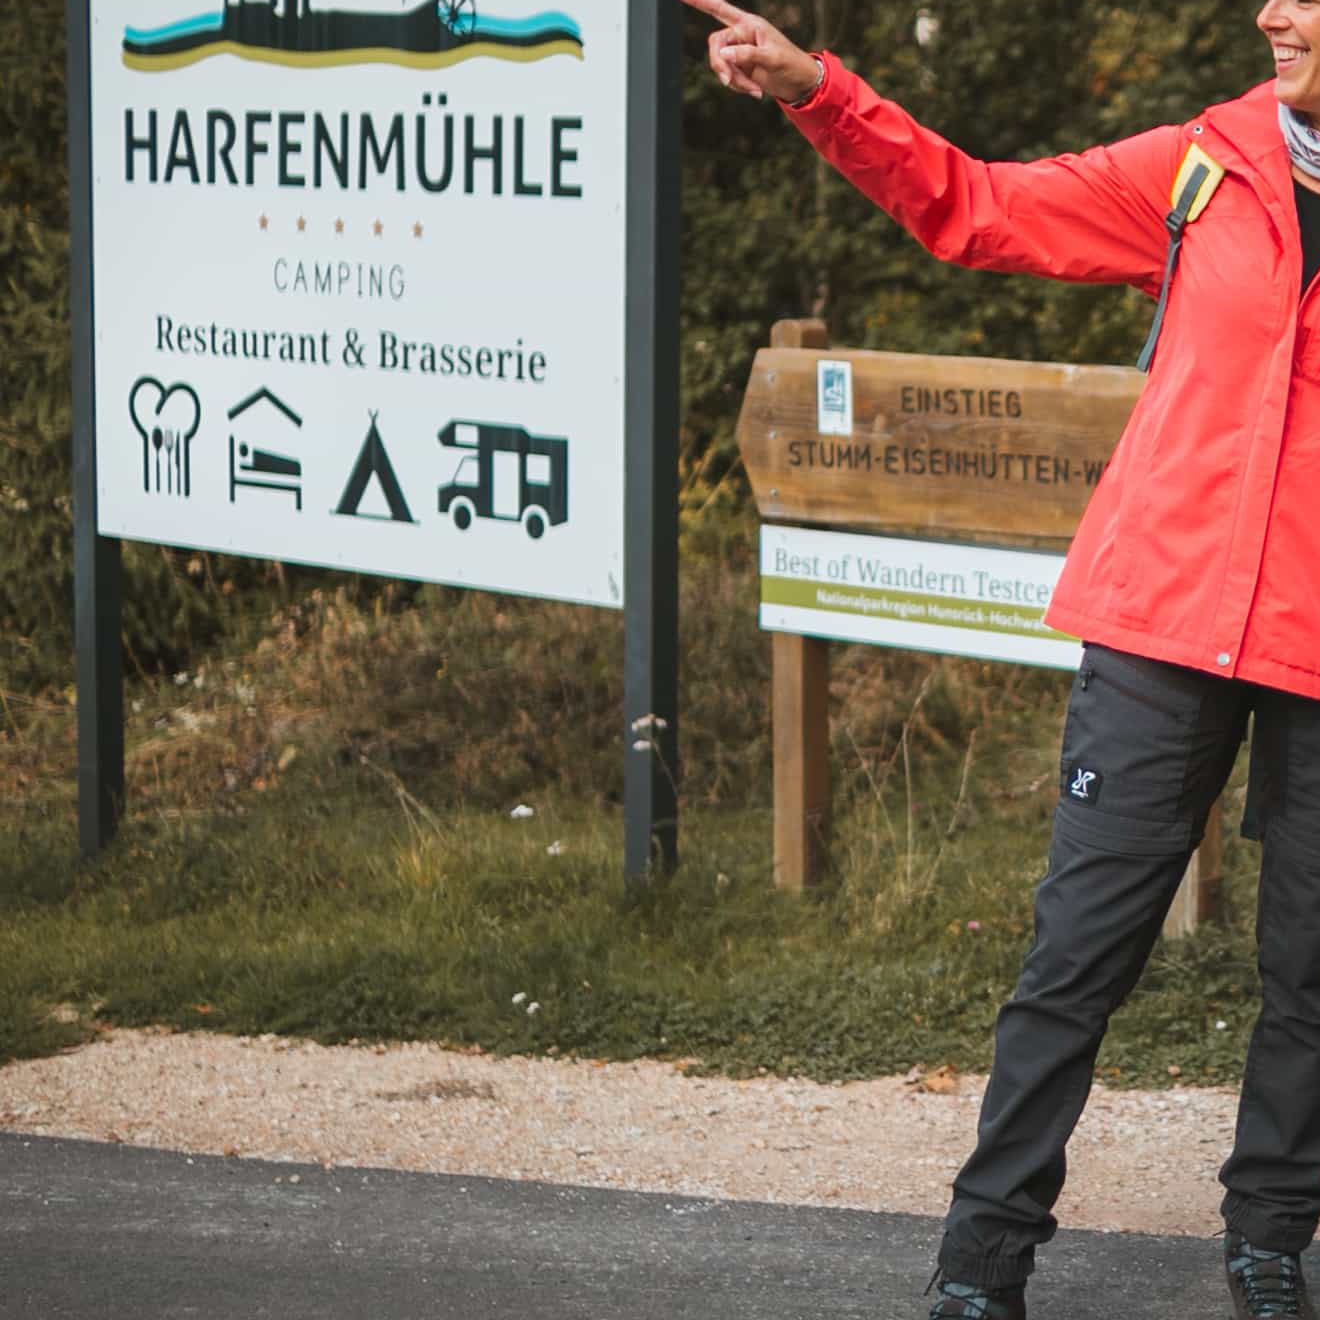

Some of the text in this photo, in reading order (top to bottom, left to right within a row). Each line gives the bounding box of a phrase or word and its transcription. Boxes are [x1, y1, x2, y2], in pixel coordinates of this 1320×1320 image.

[124, 93, 583, 198] HARFENMÜHLE
[272, 257, 406, 300] CAMPING
[155, 314, 548, 383] Restaurant & Brasserie
[900, 384, 1023, 419] EINSTIEG
[787, 440, 1104, 487] STUMM-EISENHÜTTEN-W
[774, 547, 1050, 605] Best of Wandern Testce
